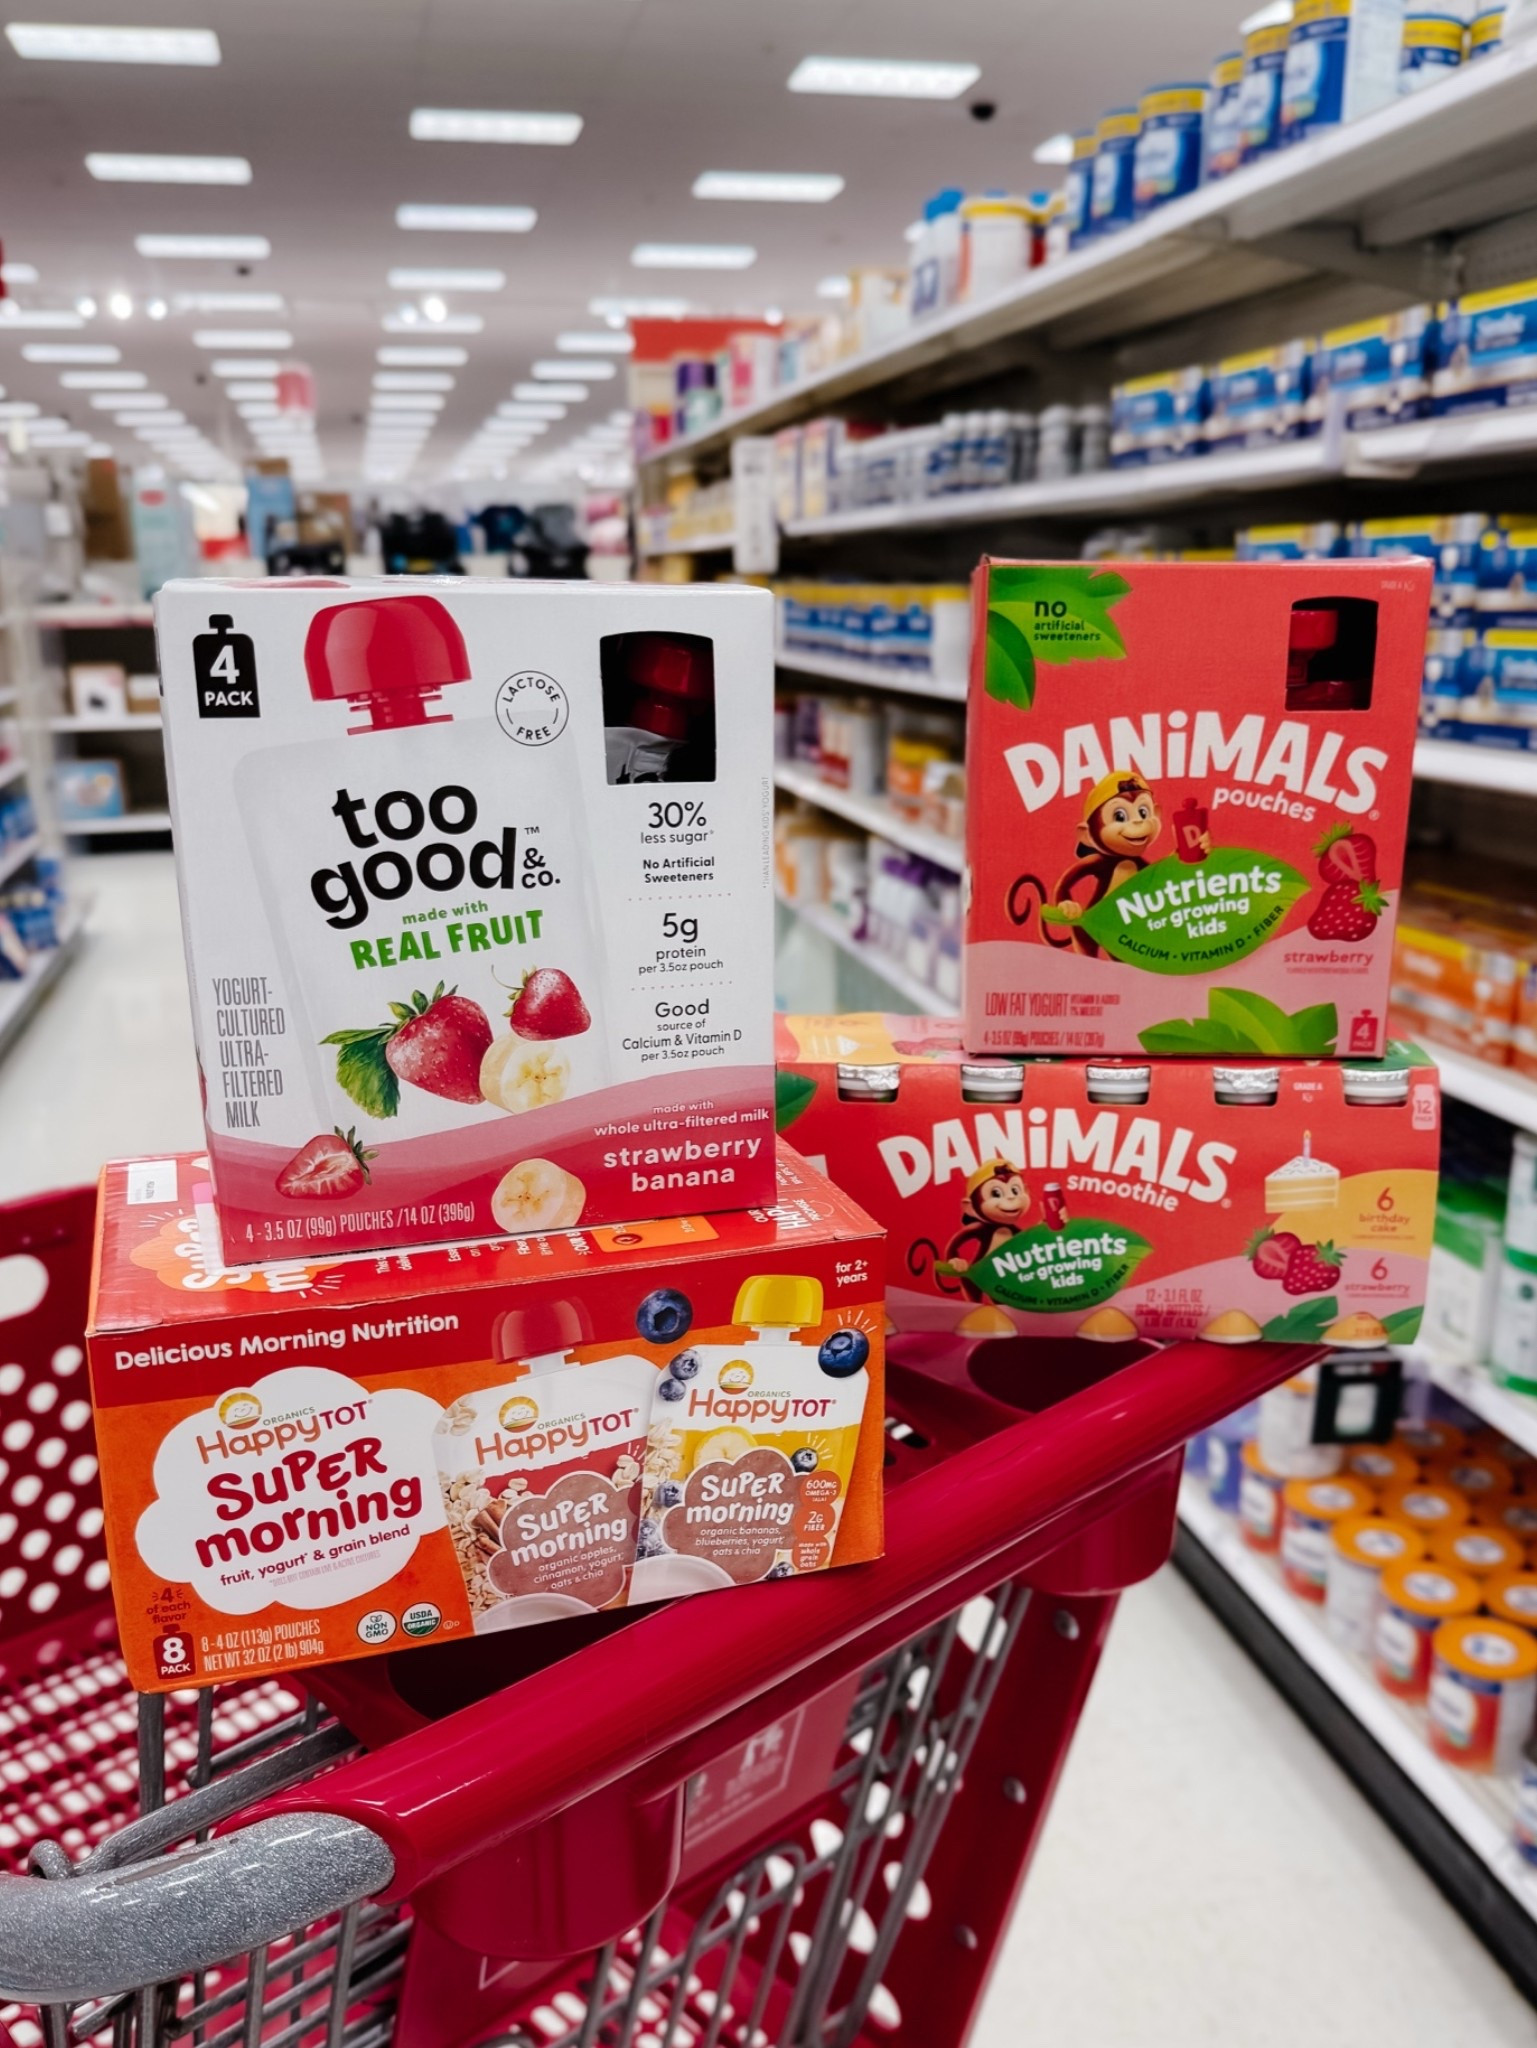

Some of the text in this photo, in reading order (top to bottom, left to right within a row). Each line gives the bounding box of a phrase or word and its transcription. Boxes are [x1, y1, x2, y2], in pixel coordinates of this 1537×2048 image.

[1034, 600, 1067, 618] no
[1034, 620, 1084, 631] artificial
[1034, 632, 1101, 641] sweeteners
[209, 645, 240, 684] 4
[205, 691, 254, 706] PACK
[502, 677, 561, 702] LACTOSE
[516, 726, 551, 740] FREE
[1212, 784, 1316, 822] pouches
[331, 784, 478, 849] too
[648, 801, 707, 829] 30%
[640, 832, 667, 844] less
[523, 847, 546, 870] &
[643, 856, 715, 870] No Artificial
[311, 827, 517, 930] good
[644, 872, 714, 883] Sweeteners
[1116, 865, 1282, 924] Nutrients
[402, 900, 489, 925] made with
[1147, 897, 1250, 931] for growing
[663, 912, 698, 943] 5g
[1118, 904, 1285, 962] CALCIUM VITAMIN D FIBER
[1187, 917, 1227, 939] kids
[350, 909, 543, 970] REAL FRUIT
[656, 945, 706, 962] protein
[1283, 950, 1374, 967] strawberry
[638, 959, 724, 976] per 3.5oz pouch
[212, 977, 273, 1006] YOGURT-
[655, 998, 710, 1017] Good
[985, 993, 1007, 1016] LOW
[1010, 993, 1026, 1015] FAT
[1029, 993, 1069, 1016] YOGURT
[216, 1007, 286, 1037] CULTURED
[657, 1018, 706, 1032] source of
[1356, 1022, 1370, 1040] 4
[622, 1029, 742, 1050] Calcium & Vitamin D
[219, 1039, 269, 1068] ULTRA-
[641, 1045, 725, 1063] per 3.5oz pouch
[222, 1069, 284, 1098] FILTERED
[225, 1100, 261, 1128] MILK
[653, 1100, 714, 1114] made with
[1416, 1099, 1432, 1114] 12
[594, 1108, 769, 1137] whole ultra-filtered milk
[603, 1137, 761, 1168] strawberry
[632, 1167, 735, 1192] banana
[1067, 1175, 1179, 1212] smoothie
[1377, 1187, 1395, 1211] 6
[245, 1223, 254, 1243] 4
[264, 1220, 283, 1242] 3.5
[286, 1218, 303, 1239] OZ
[305, 1214, 337, 1239] (99g)
[340, 1210, 394, 1234] POUCHES
[421, 1205, 436, 1226] OZ
[438, 1201, 476, 1225] (396g)
[1359, 1213, 1411, 1225] birthday
[835, 1259, 868, 1273] for 2+
[992, 1233, 1127, 1278] Nutrients
[836, 1272, 868, 1287] years
[1018, 1257, 1103, 1283] for growing
[1370, 1257, 1388, 1280] 6
[994, 1284, 1038, 1305] CALCIUM
[1047, 1293, 1090, 1306] VITAMIN
[1104, 1263, 1131, 1288] FIBER
[1051, 1272, 1084, 1289] kids
[1344, 1283, 1410, 1294] strawberry
[115, 1313, 459, 1371] Delicious Morning Nutrition
[263, 1405, 316, 1427] ORGANICS
[537, 1412, 587, 1431] ORGANICS
[195, 1476, 423, 1568] morning
[686, 1497, 794, 1525] morning
[700, 1526, 781, 1537] organic bananas,
[803, 1523, 825, 1531] FIBER
[510, 1517, 628, 1567] morning
[695, 1537, 749, 1546] blueberries,
[713, 1547, 761, 1556] oats chia
[220, 1568, 255, 1586] fruit,
[313, 1550, 325, 1561] &
[329, 1538, 366, 1560] grain
[369, 1524, 411, 1546] blend
[538, 1545, 617, 1572] organic apples,
[533, 1563, 587, 1585] cinnamon,
[550, 1568, 604, 1590] oats chia
[160, 1587, 174, 1603] 4
[146, 1601, 191, 1615] of each
[152, 1612, 187, 1624] flavor
[410, 1609, 433, 1620] USDA
[202, 1618, 321, 1652] 8 4 OZ (113g) POUCHES
[365, 1629, 389, 1638] GMO
[366, 1621, 388, 1632] NON
[407, 1619, 437, 1630] ORGANIC
[162, 1637, 186, 1664] 8
[203, 1639, 325, 1671] NET WT 32 OZ (2 lb) 904g
[161, 1662, 191, 1675] PACK
